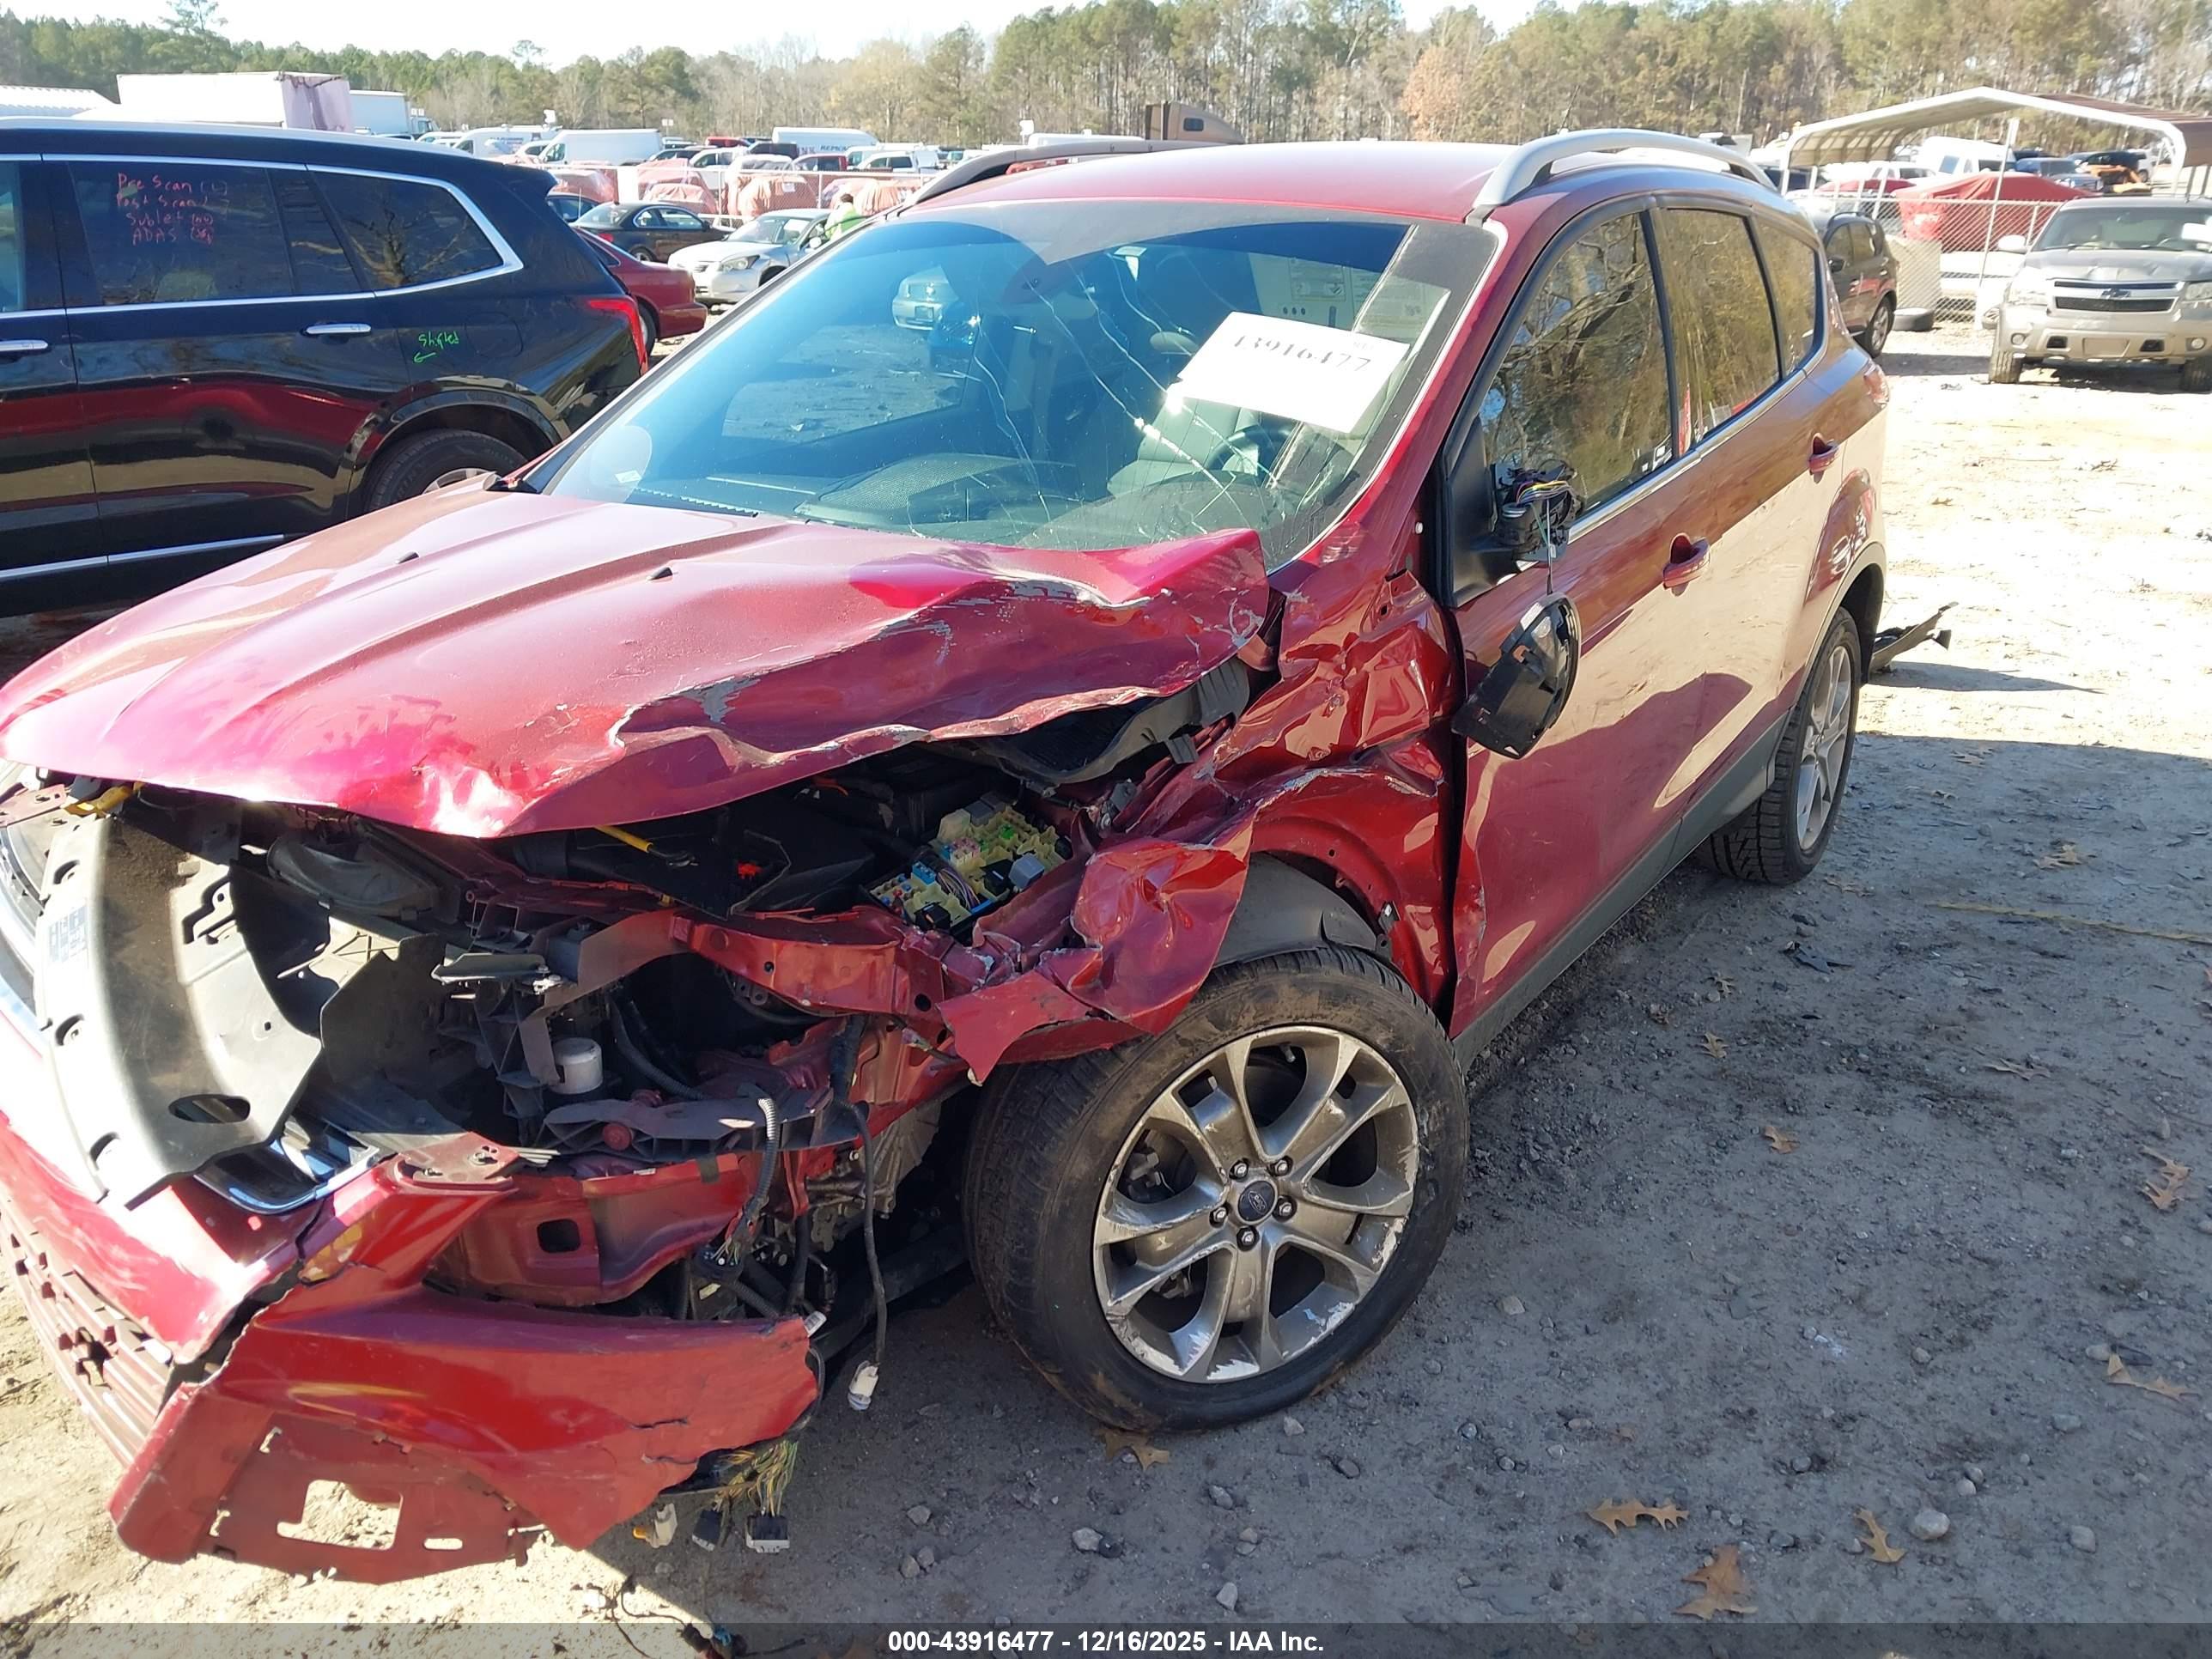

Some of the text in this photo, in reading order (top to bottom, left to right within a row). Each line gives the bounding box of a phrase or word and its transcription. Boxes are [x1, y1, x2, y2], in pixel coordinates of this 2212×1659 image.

[117, 172, 144, 190] Pre
[152, 174, 192, 193] Scan
[158, 194, 197, 207] Scan
[132, 227, 177, 246] ADAS
